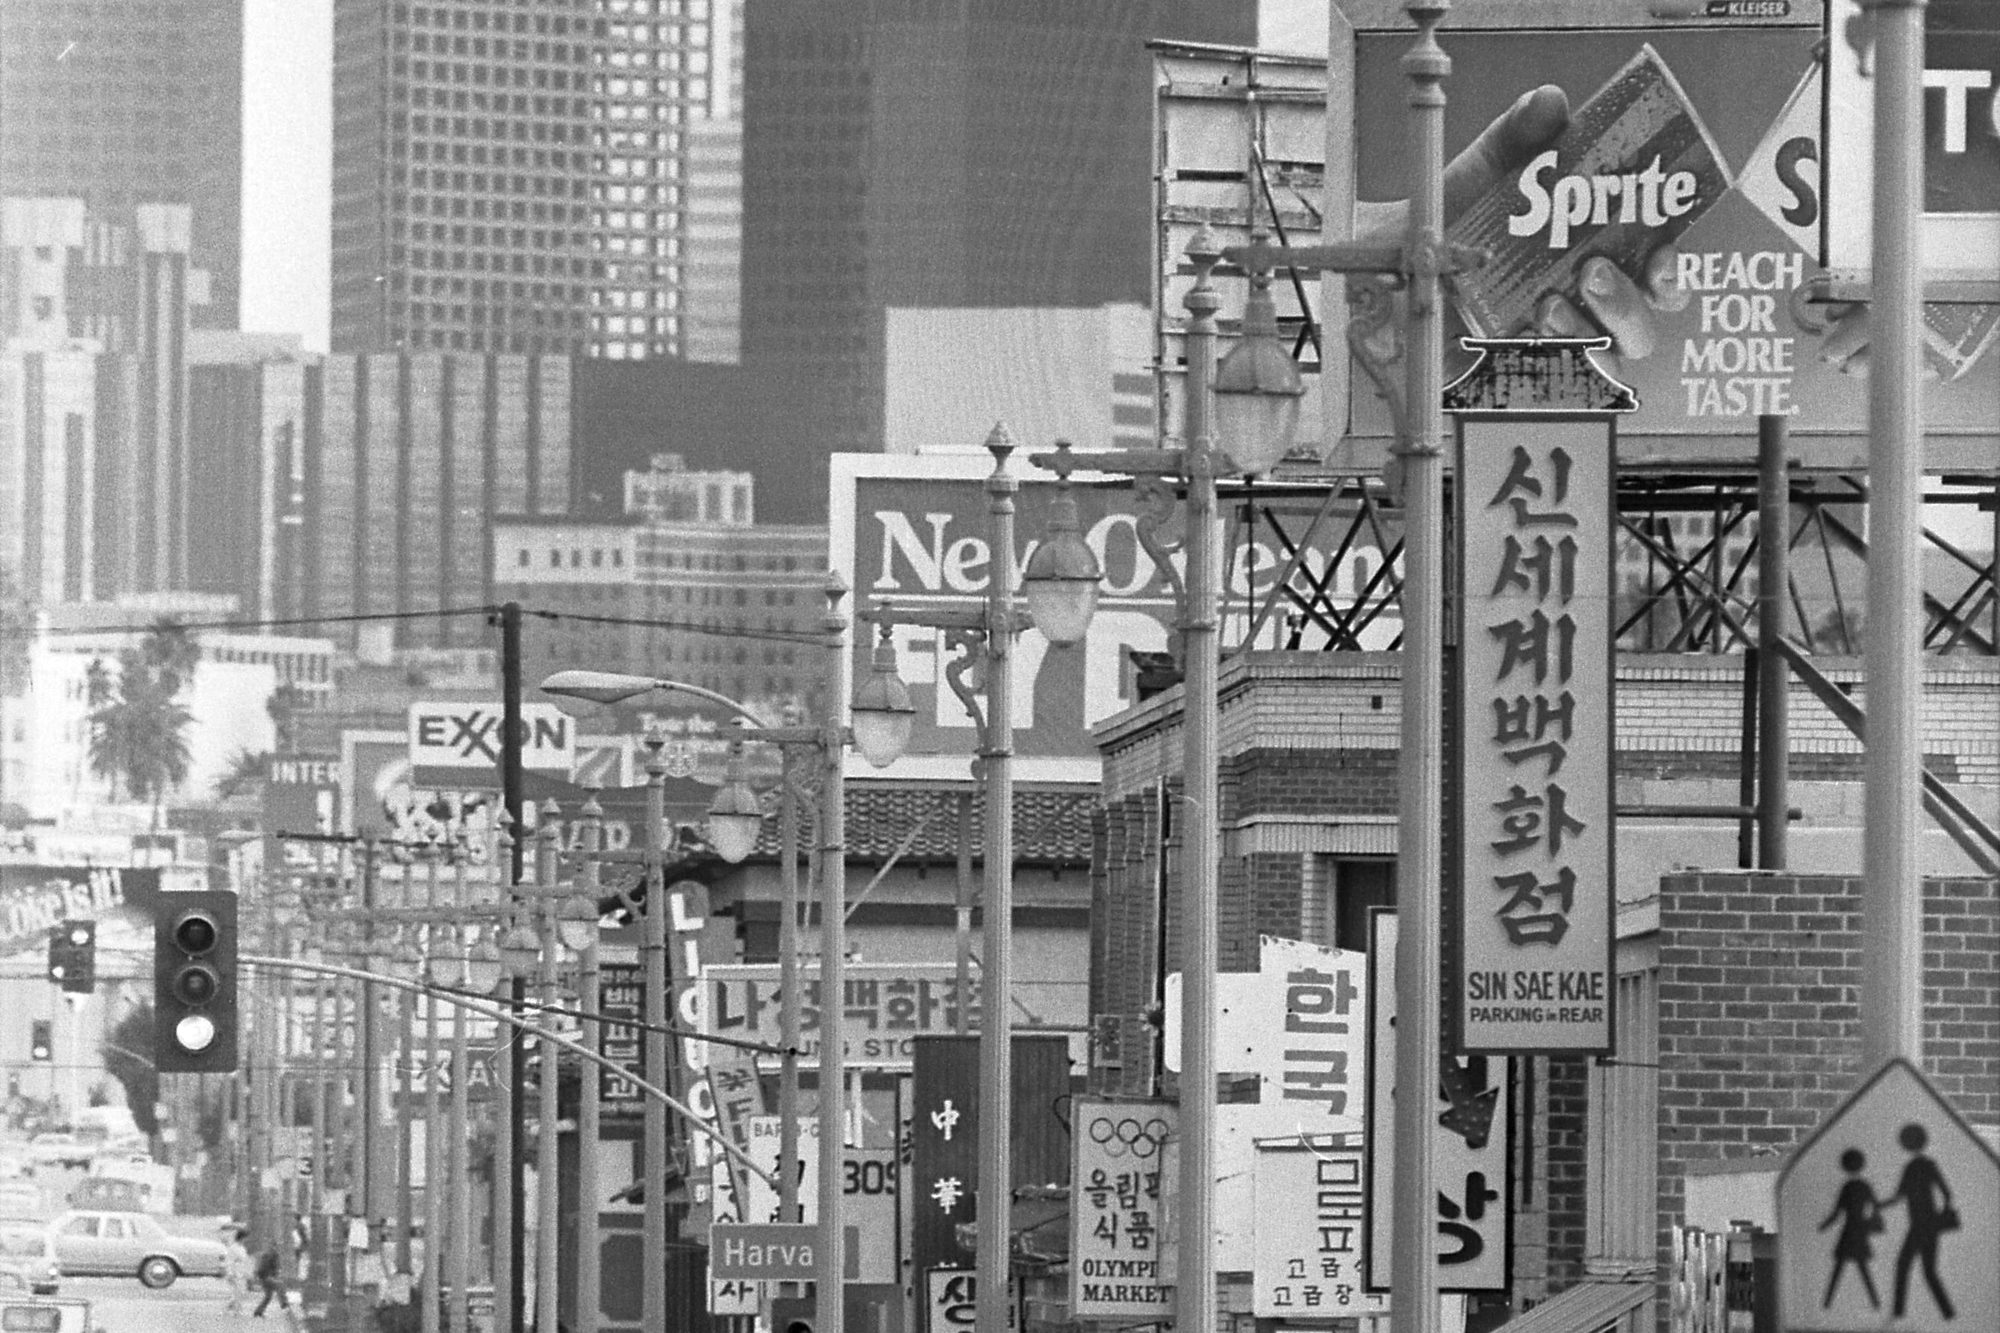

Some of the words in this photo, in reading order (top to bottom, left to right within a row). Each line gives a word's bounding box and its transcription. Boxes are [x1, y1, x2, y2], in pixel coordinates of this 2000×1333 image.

[1921, 68, 2000, 154] T
[1508, 150, 1701, 249] Sprite
[1676, 251, 1803, 291] REACH
[1701, 294, 1777, 333] FOR
[1681, 338, 1795, 374] MORE
[1680, 378, 1800, 417] TASTE.
[1085, 513, 1405, 598] Olean
[1484, 444, 1588, 948] 신세계백화점
[418, 709, 566, 764] EXXON
[1468, 970, 1507, 1001] SIN
[1513, 970, 1554, 1001] SAE
[1559, 970, 1604, 1001] KAE
[1470, 1006, 1543, 1023] PARKING
[1559, 1006, 1604, 1023] REAR
[1093, 1211, 1155, 1250] 식품
[1082, 1259, 1159, 1278] OLYMPI
[1082, 1284, 1170, 1303] MARKET
